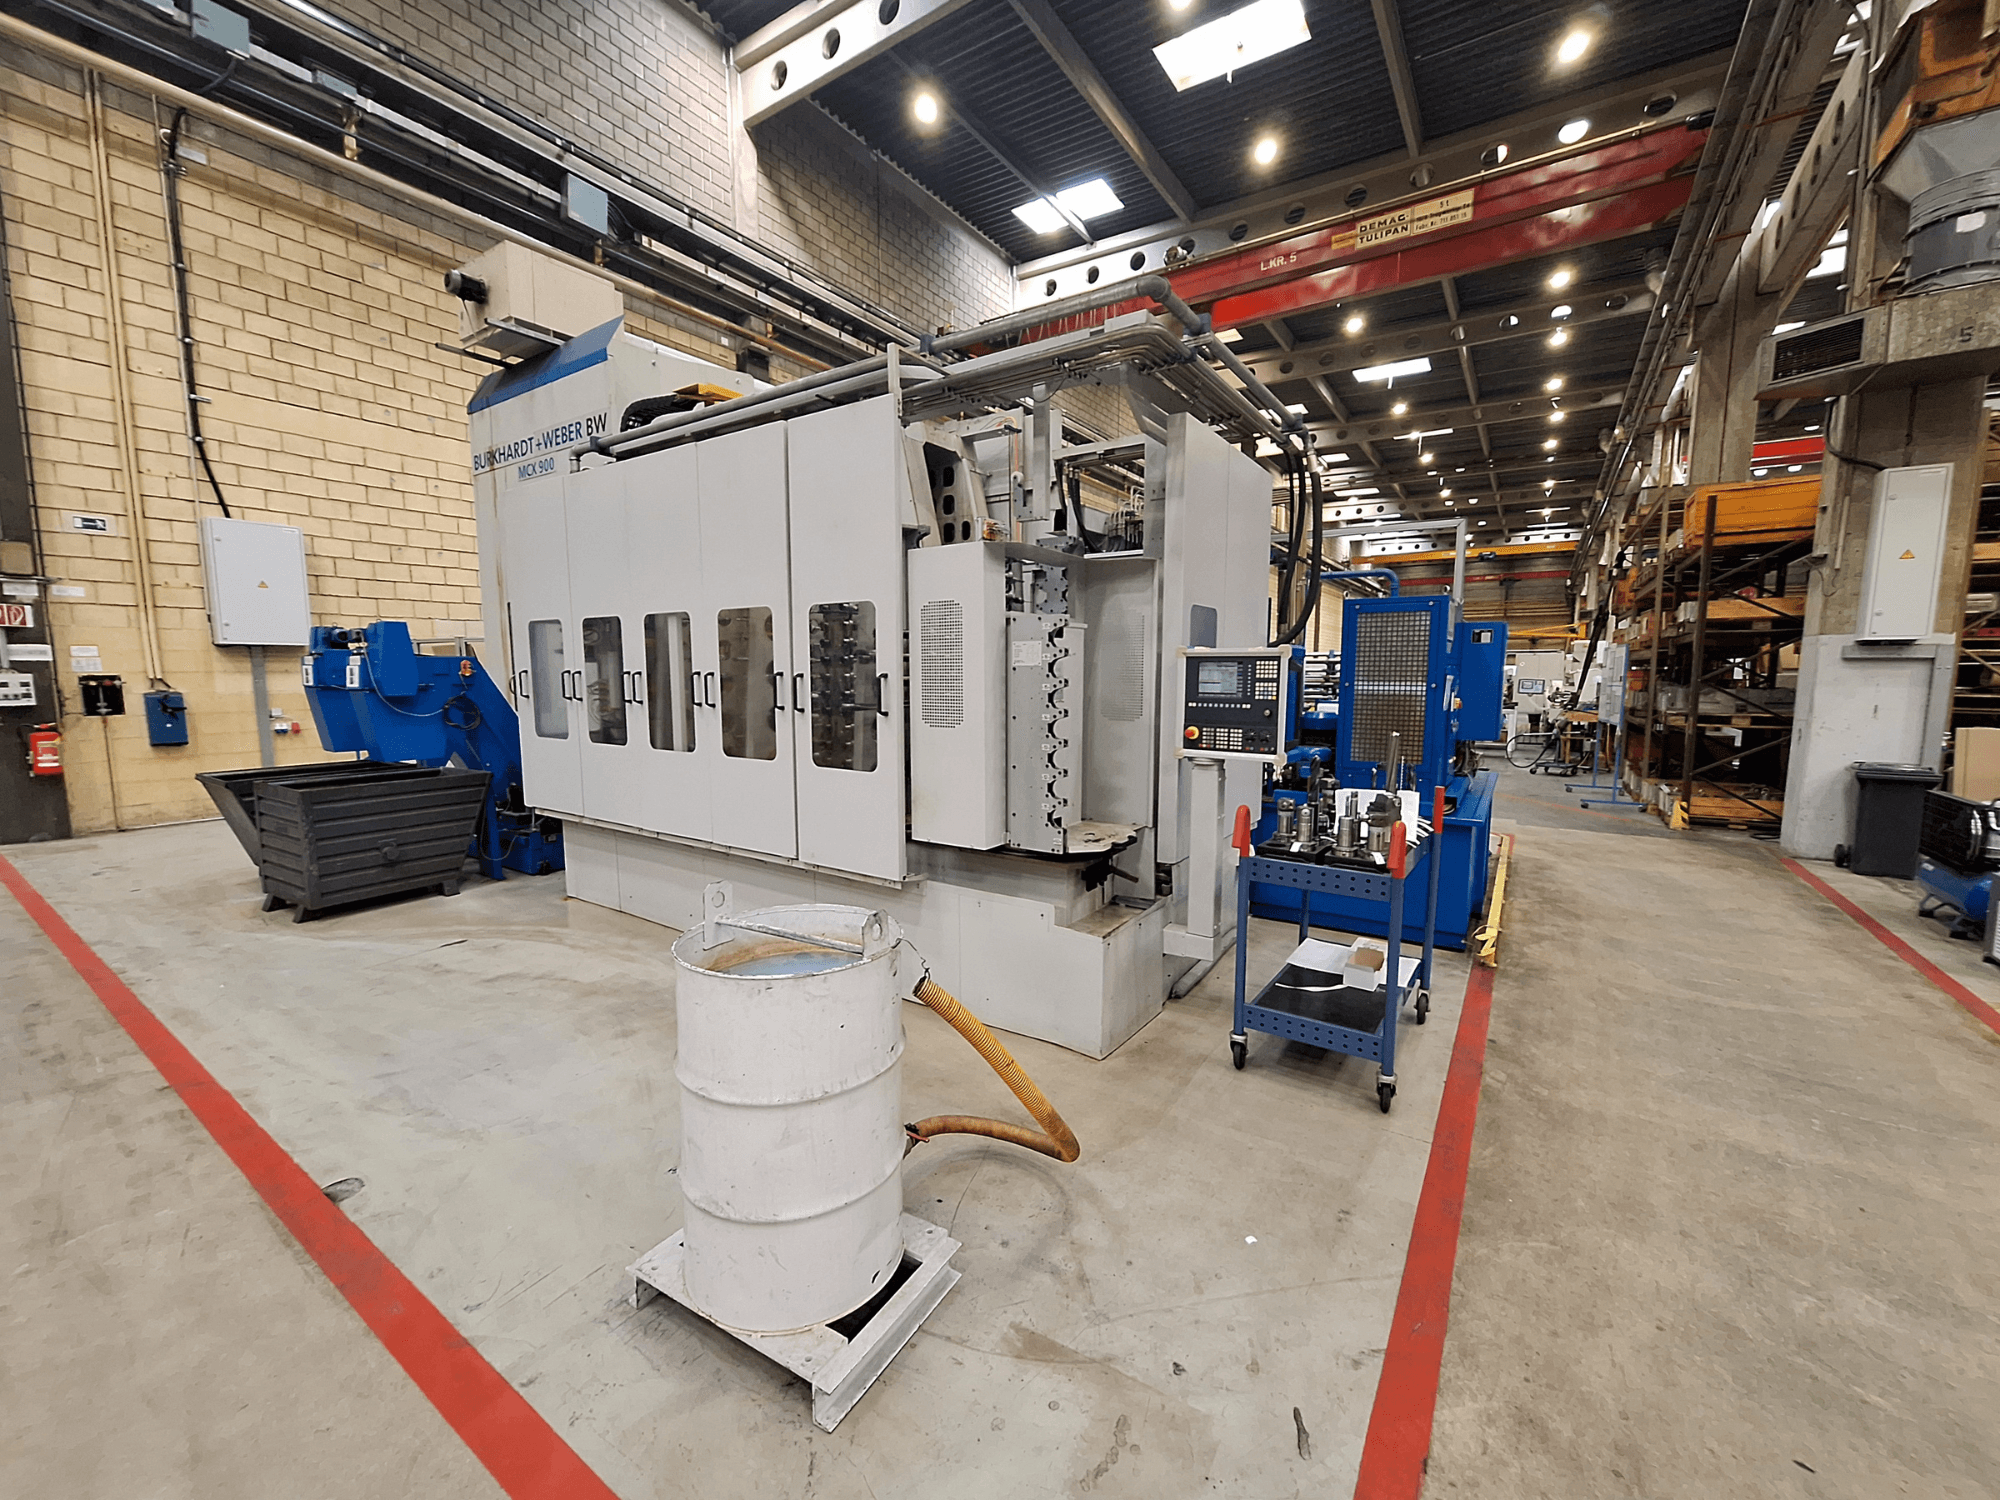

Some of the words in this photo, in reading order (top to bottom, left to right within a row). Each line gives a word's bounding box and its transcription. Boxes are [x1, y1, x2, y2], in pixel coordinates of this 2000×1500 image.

[1359, 224, 1409, 244] TULIPAN
[1289, 251, 1297, 263] 5
[1959, 326, 1975, 343] 5
[585, 412, 607, 436] BW
[518, 463, 537, 479] MCX
[539, 457, 555, 473] 900
